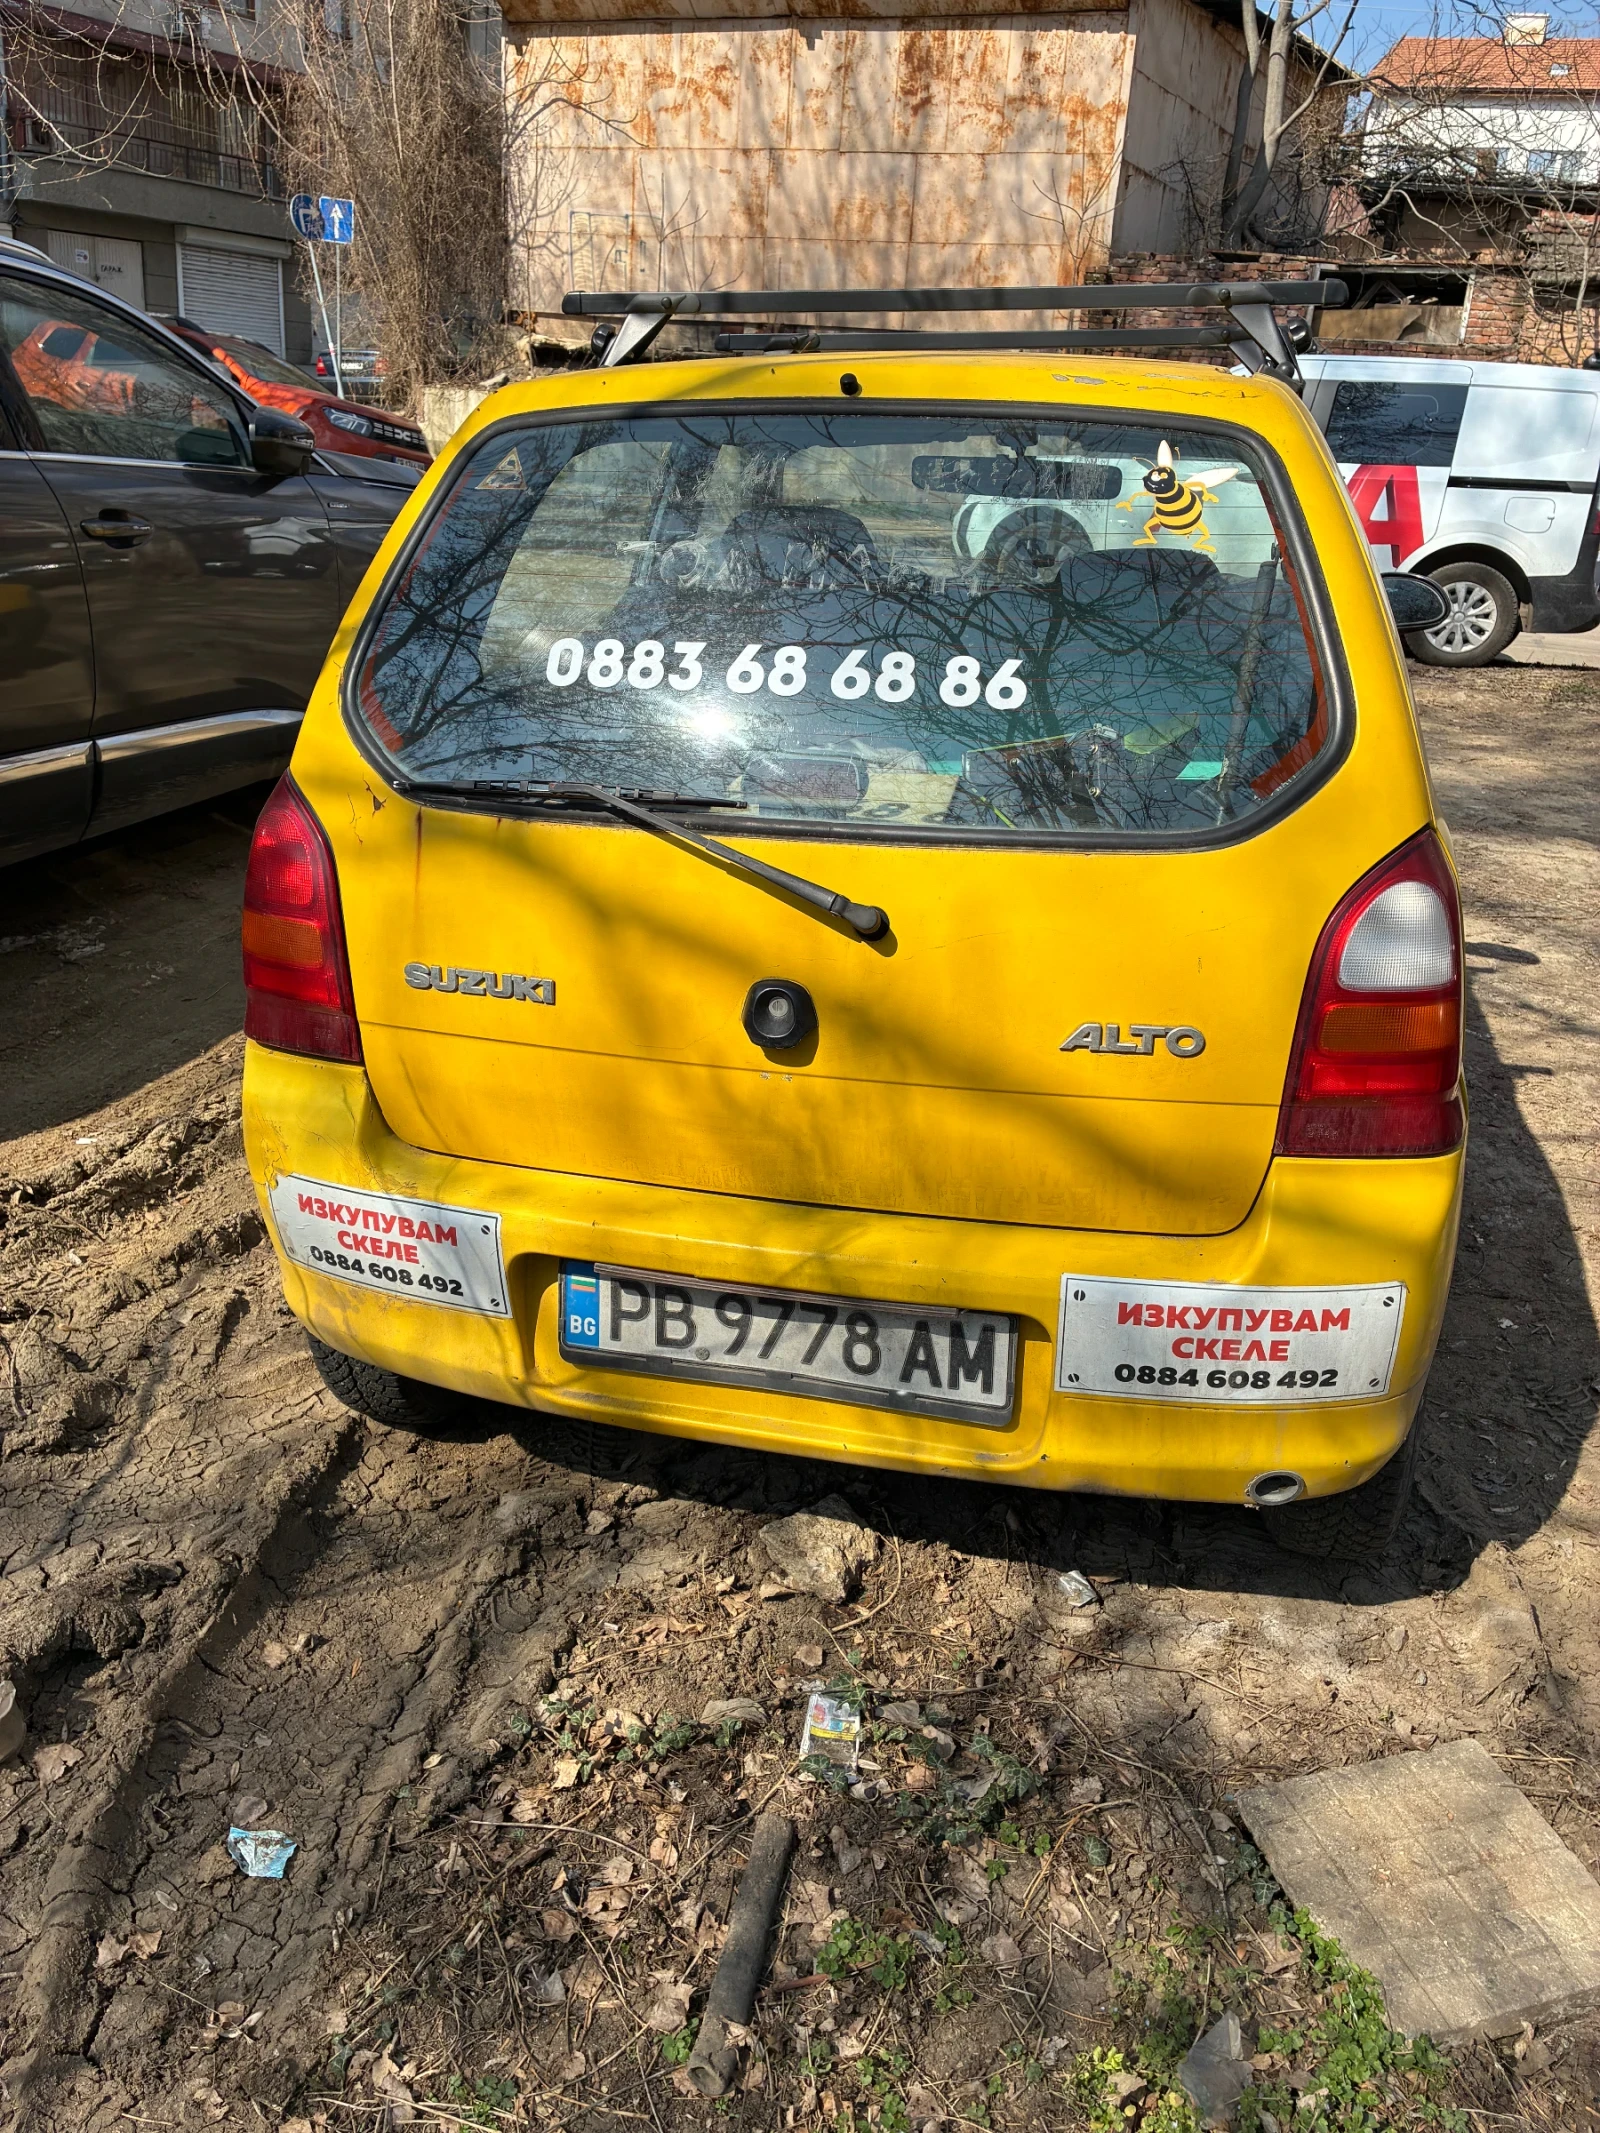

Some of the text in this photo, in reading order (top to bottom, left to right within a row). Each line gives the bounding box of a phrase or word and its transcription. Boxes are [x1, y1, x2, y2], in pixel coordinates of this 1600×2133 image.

[546, 637, 1028, 710] 0883 68 68 86
[404, 961, 556, 1006] SUZUKI
[1059, 1022, 1206, 1058] ALTO
[298, 1193, 458, 1247] ИЗКУПУВАМ
[337, 1230, 419, 1265] СКЕЛЕ
[310, 1245, 464, 1297] 0884 608 492
[570, 1314, 597, 1336] BG
[609, 1277, 996, 1394] PB 9778 AM
[1117, 1302, 1350, 1333] ИЗКУПУВАМ
[1171, 1336, 1290, 1361] СКЕЛЕ
[1114, 1364, 1338, 1389] 0884 608 492
